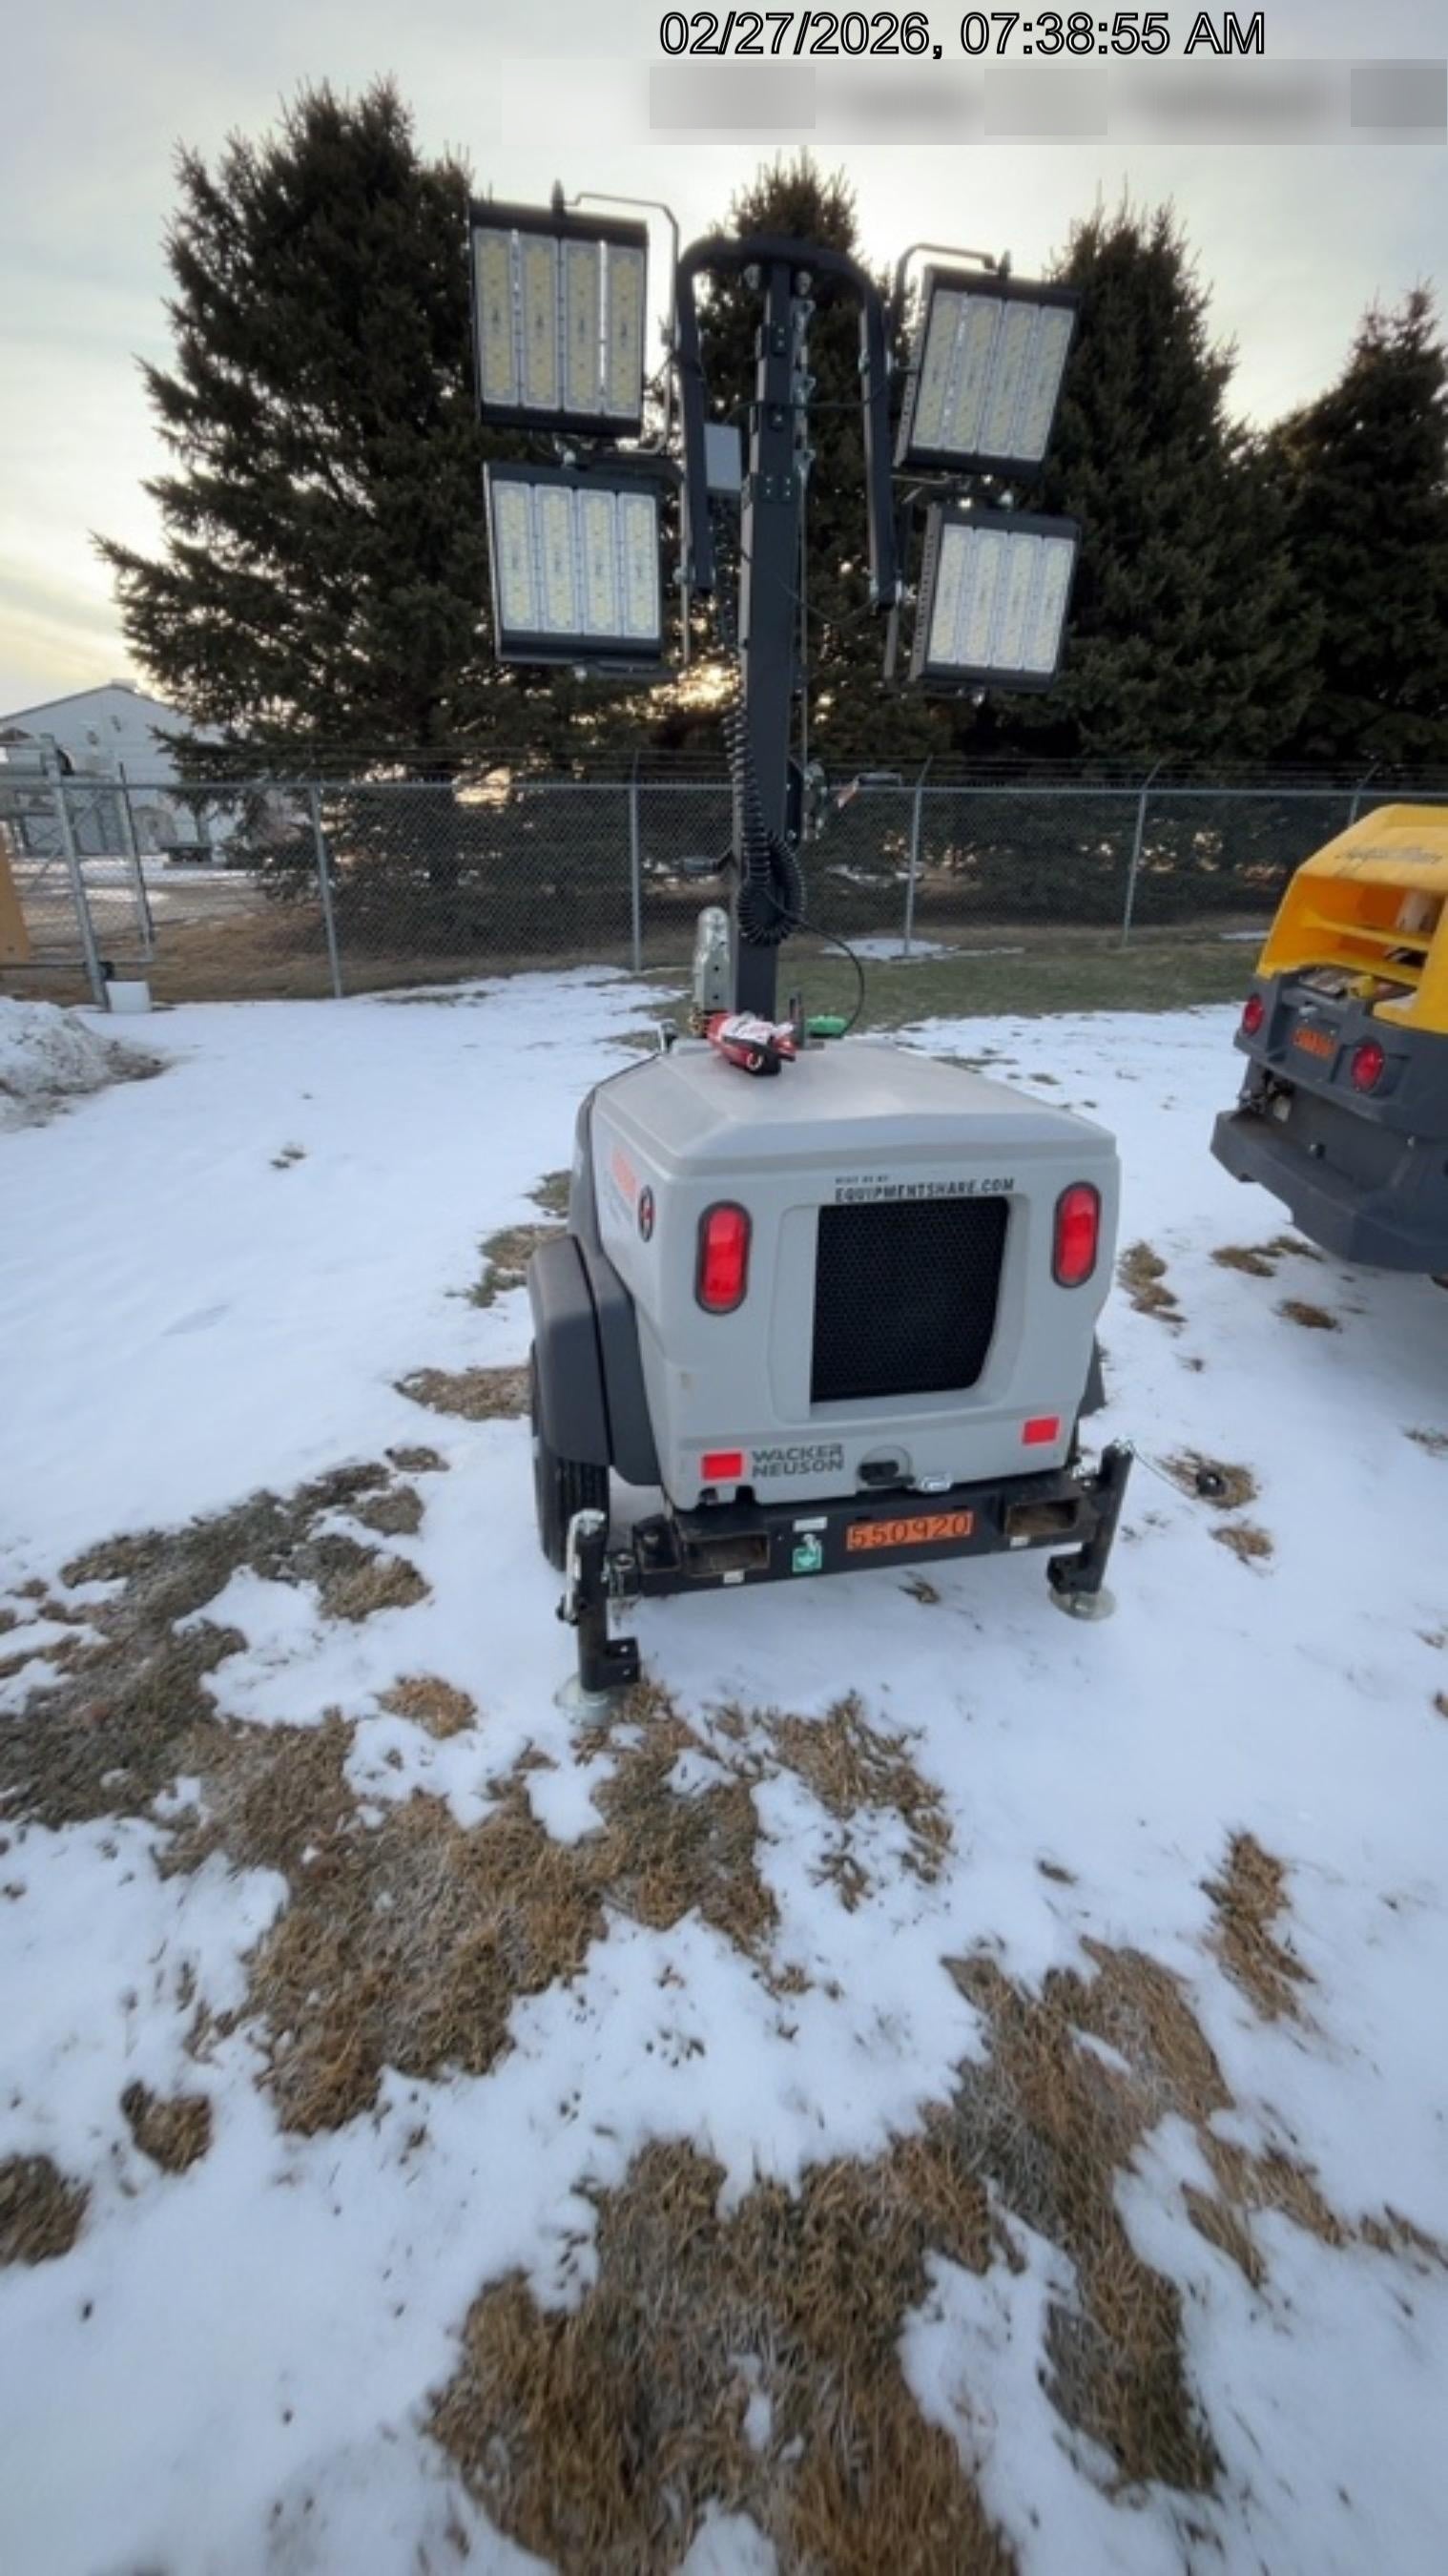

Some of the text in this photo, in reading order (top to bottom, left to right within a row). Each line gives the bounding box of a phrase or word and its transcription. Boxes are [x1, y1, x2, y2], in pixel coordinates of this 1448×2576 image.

[752, 1444, 843, 1464] WACKER
[752, 1459, 844, 1479] NEUSON
[850, 1514, 970, 1548] 550920
